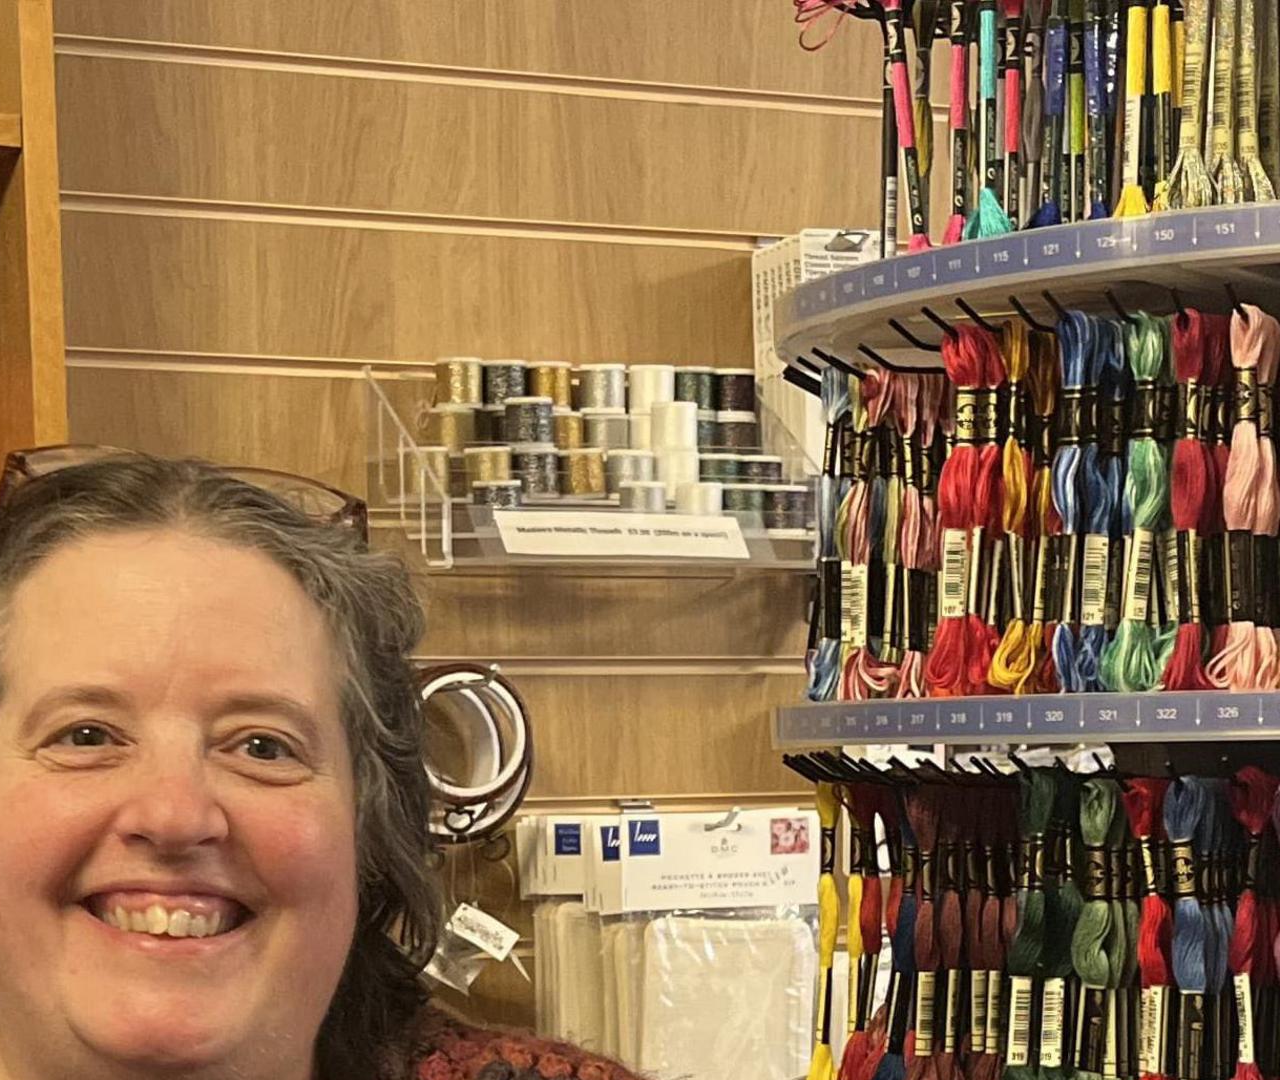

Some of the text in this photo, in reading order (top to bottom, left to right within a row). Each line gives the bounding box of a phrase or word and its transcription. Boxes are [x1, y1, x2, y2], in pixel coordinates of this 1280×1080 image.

[1042, 243, 1060, 256] 121
[1154, 228, 1175, 241] 150
[1215, 222, 1235, 235] 151
[995, 711, 1013, 723] 319
[1045, 710, 1064, 722] 320
[1098, 709, 1118, 721] 321
[1156, 708, 1177, 720] 322
[1217, 706, 1239, 719] 326
